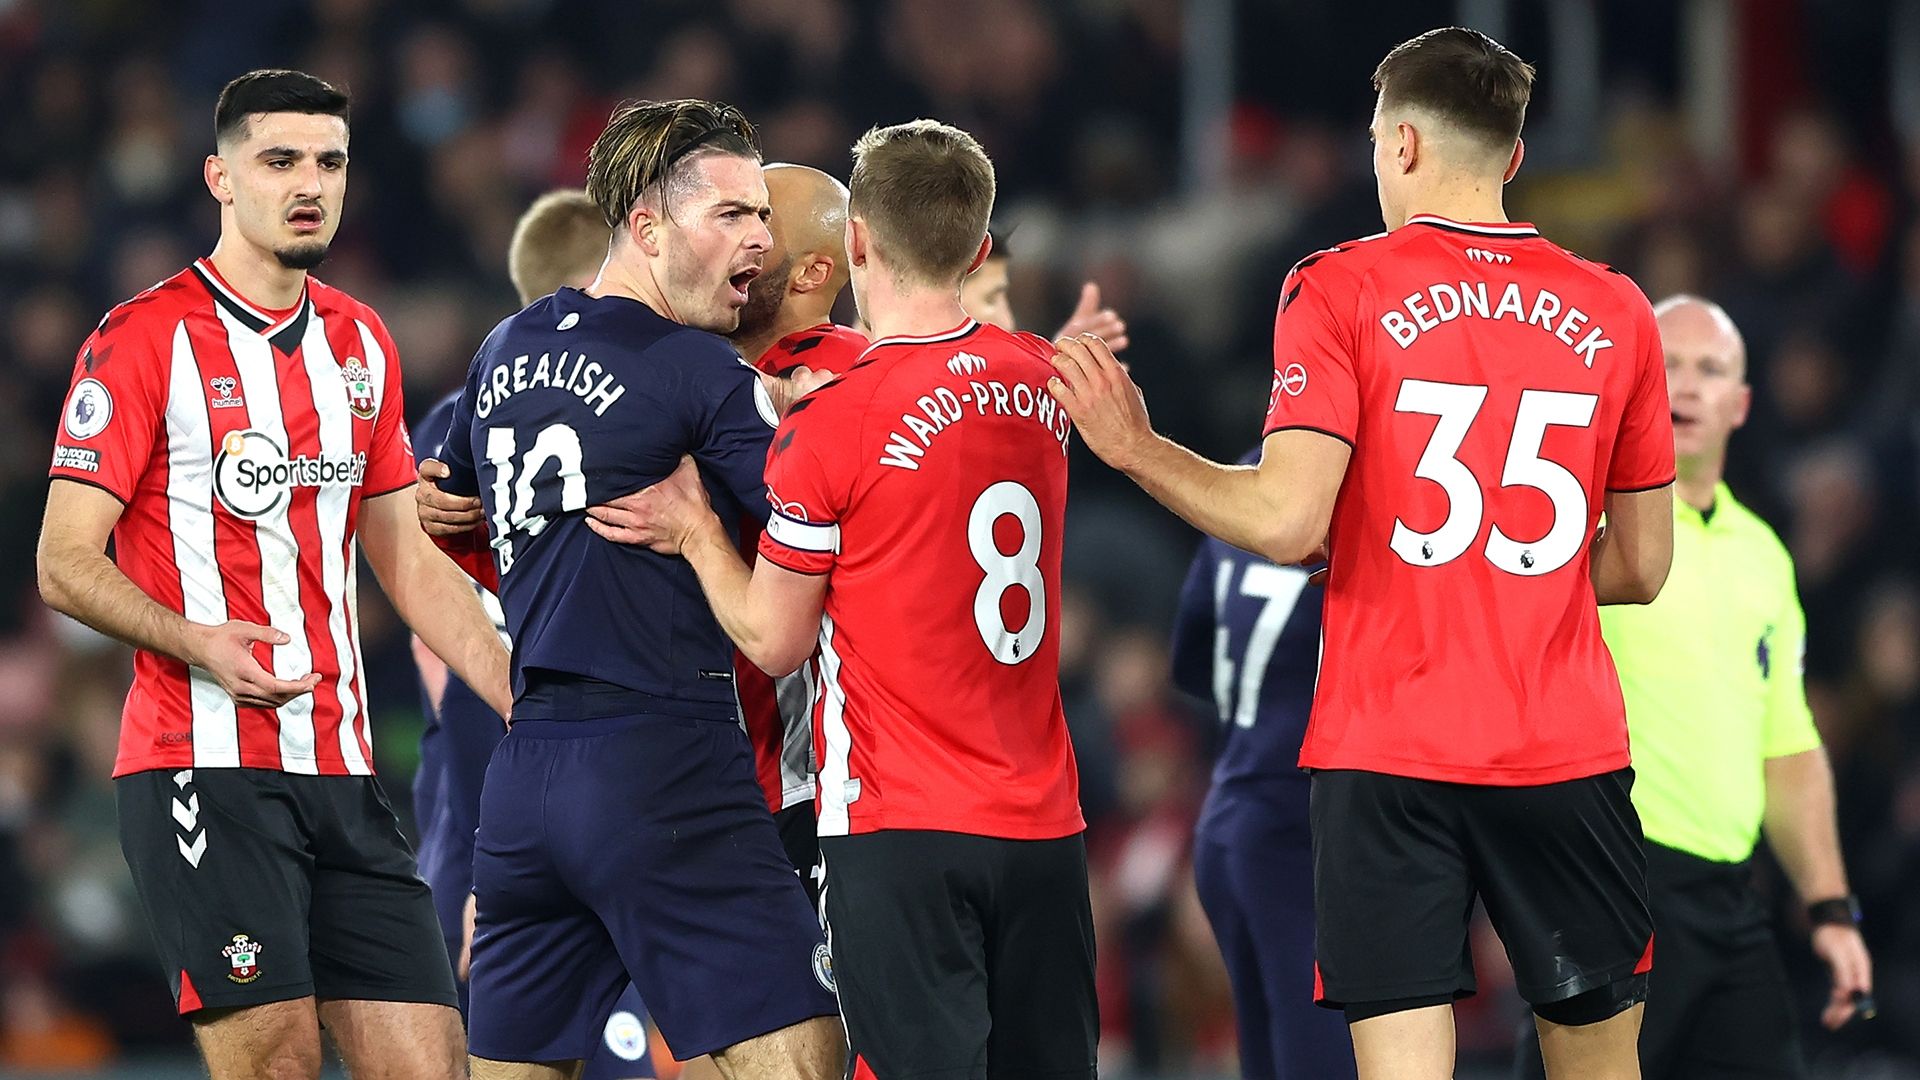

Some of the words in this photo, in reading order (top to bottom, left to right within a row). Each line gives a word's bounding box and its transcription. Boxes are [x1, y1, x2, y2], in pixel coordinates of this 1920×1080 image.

[1380, 281, 1614, 368] BEDNAREK
[213, 398, 242, 406] hummel
[475, 350, 626, 418] GREALISH
[64, 458, 99, 473] racism
[68, 448, 97, 462] room
[1390, 379, 1599, 576] 35
[485, 424, 588, 576] 10
[967, 480, 1046, 665] 8
